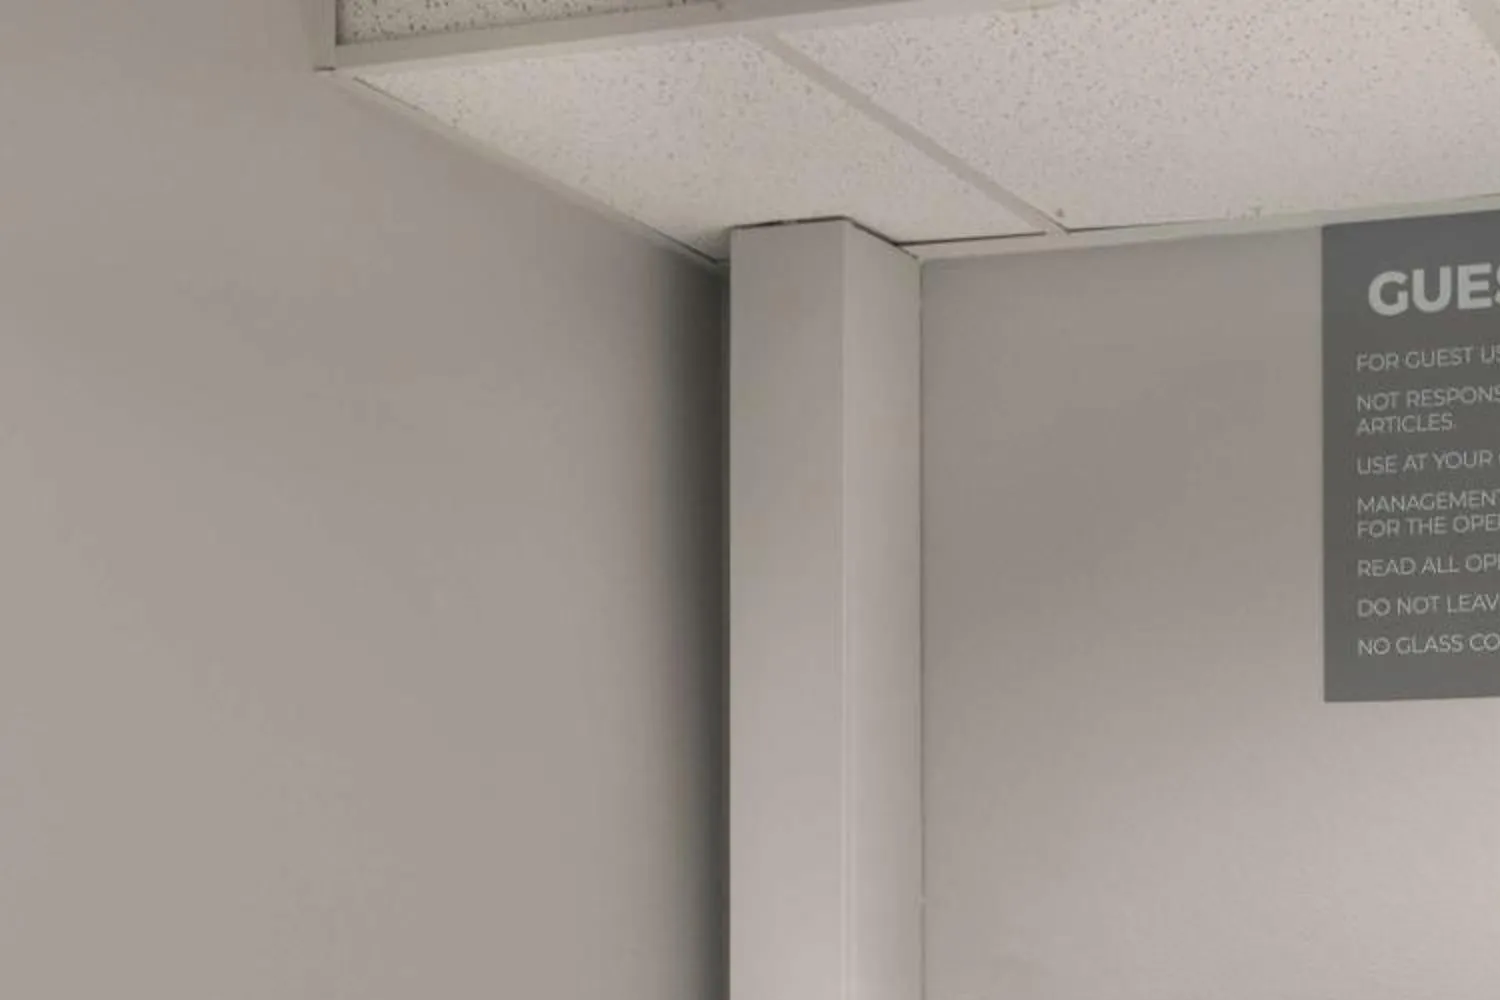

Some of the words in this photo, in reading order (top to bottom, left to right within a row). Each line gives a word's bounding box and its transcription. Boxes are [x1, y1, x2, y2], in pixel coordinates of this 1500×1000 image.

[1356, 352, 1399, 372] FOR
[1404, 346, 1474, 369] GUEST
[1356, 391, 1400, 412] NOT
[1356, 454, 1397, 475] USE
[1402, 453, 1428, 472] AT
[1431, 450, 1493, 470] YOUR
[1357, 519, 1400, 541] FOR
[1404, 516, 1447, 535] THE
[1357, 557, 1417, 577] READ
[1420, 556, 1460, 574] ALL
[1357, 598, 1391, 617] DO
[1396, 596, 1440, 616] NOT
[1357, 637, 1391, 656] NO
[1395, 633, 1464, 655] GLASS
